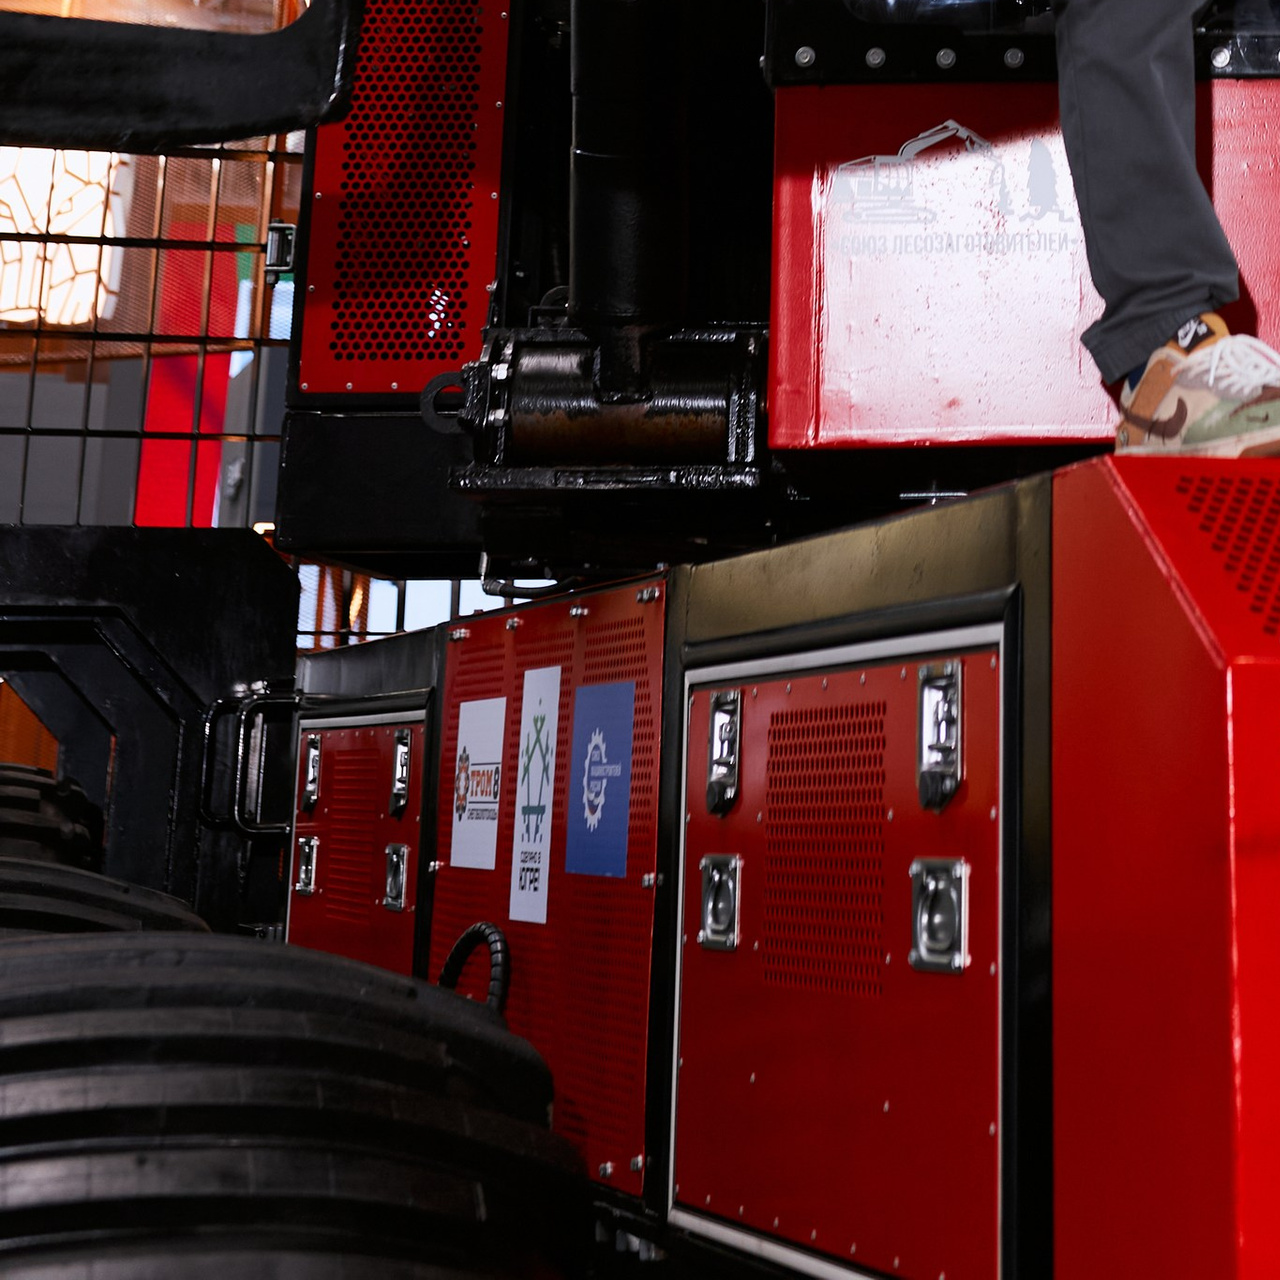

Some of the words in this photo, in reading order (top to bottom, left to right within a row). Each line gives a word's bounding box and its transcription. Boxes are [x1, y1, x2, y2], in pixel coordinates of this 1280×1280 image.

[840, 233, 888, 255] СОЮЗ
[470, 769, 493, 797] ТРОМ
[493, 766, 500, 800] 8
